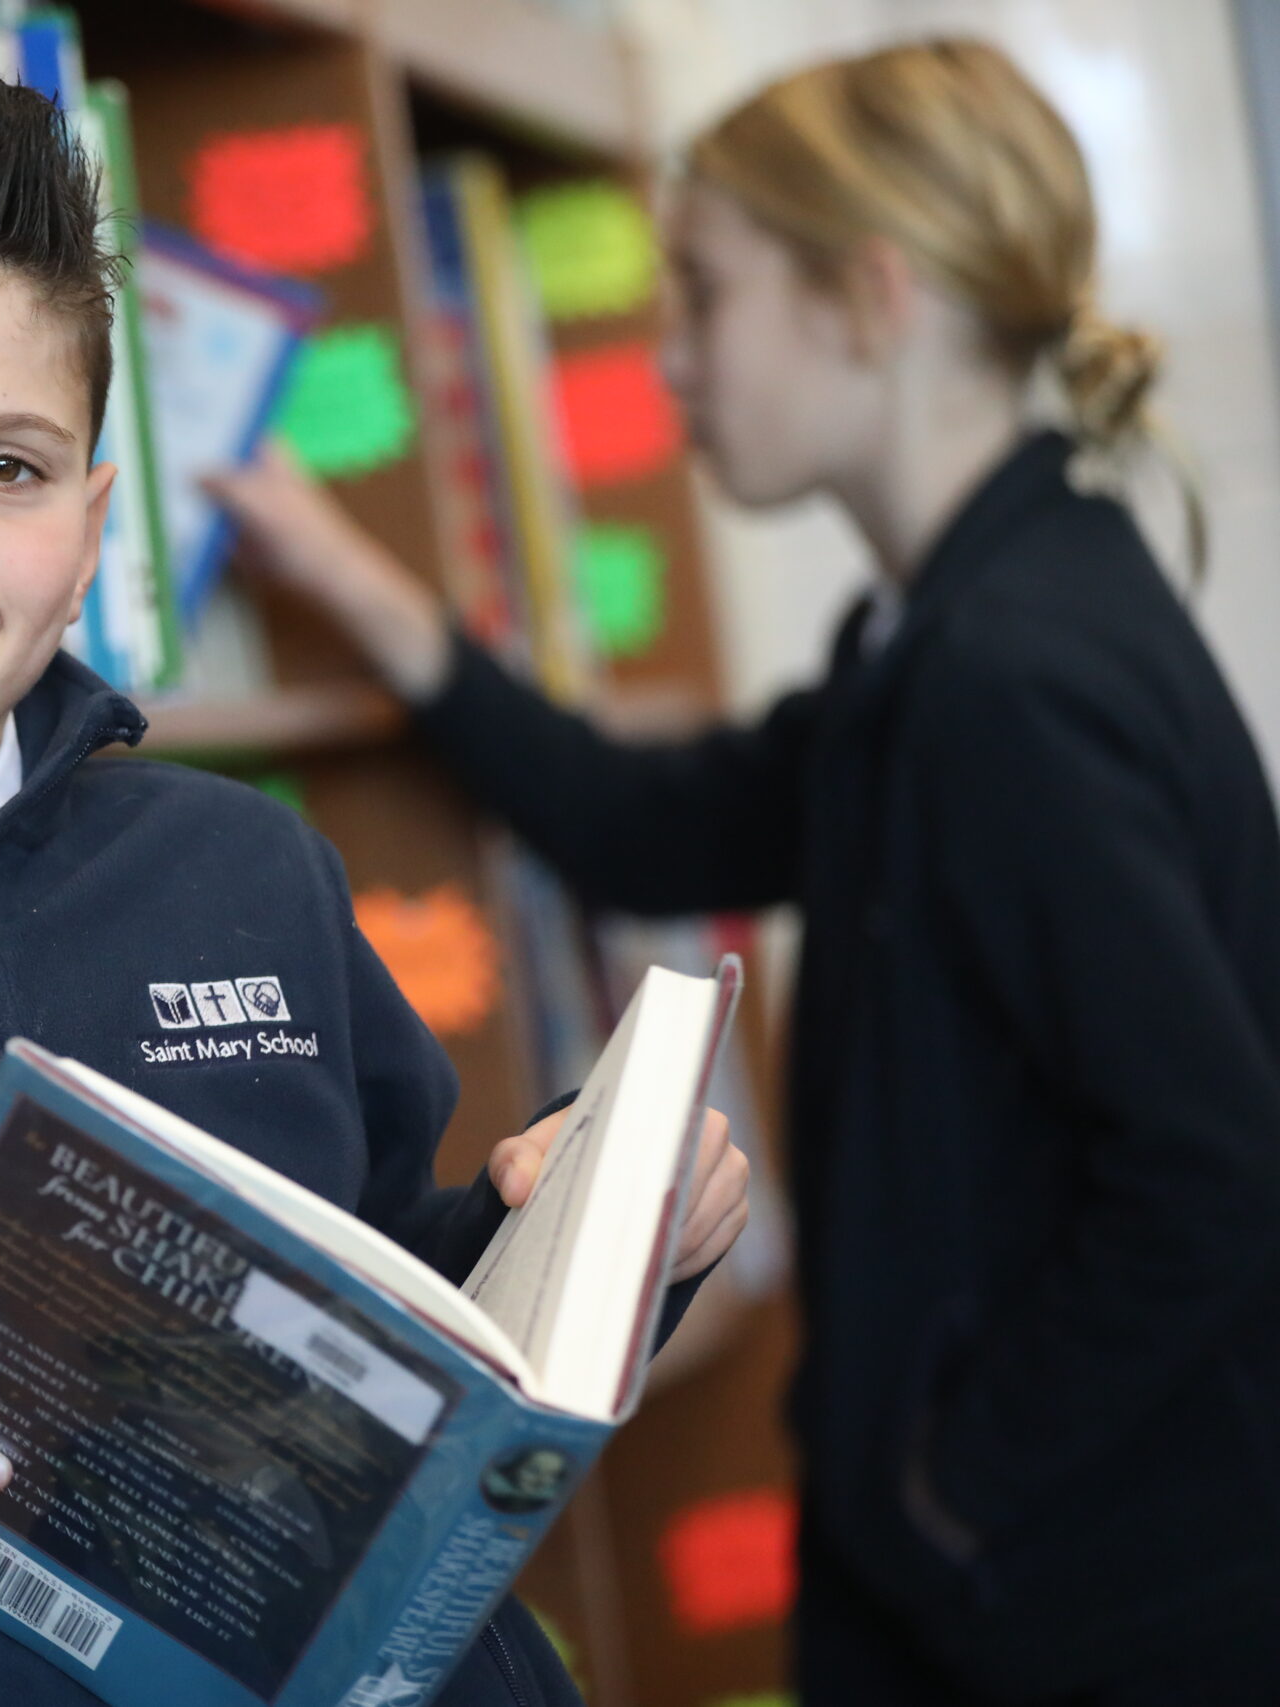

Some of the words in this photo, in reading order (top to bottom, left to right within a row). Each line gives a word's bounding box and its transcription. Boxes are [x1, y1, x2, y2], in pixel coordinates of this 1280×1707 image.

[140, 1038, 194, 1063] Saint
[195, 1037, 252, 1060] Mary
[257, 1029, 320, 1057] School
[36, 1173, 108, 1223] from
[50, 1142, 248, 1278] BEAUTIFU
[60, 1219, 109, 1251] for
[7, 1348, 67, 1391] TEMPEST
[33, 1406, 94, 1448] MEASURE
[127, 1468, 188, 1510] MEASURE
[34, 1446, 65, 1470] TALE
[23, 1499, 45, 1518] OF
[46, 1515, 95, 1551] VENICE
[33, 1487, 97, 1531] NOTHING
[107, 1474, 142, 1500] WELL
[146, 1500, 181, 1525] THAT
[72, 1491, 104, 1516] TWO
[103, 1512, 185, 1569] GENTLEMEN
[185, 1566, 205, 1583] OF
[207, 1582, 262, 1621] VERONA
[107, 1494, 133, 1514] THE
[135, 1512, 191, 1552] COMEDY
[192, 1550, 210, 1566] OF
[214, 1566, 267, 1603] ERRORS
[136, 1574, 154, 1591] AS
[154, 1586, 181, 1608] YOU
[184, 1606, 216, 1631] LIKE
[216, 1628, 232, 1642] IT
[137, 1555, 181, 1587] TIMON
[180, 1583, 199, 1600] OF
[205, 1600, 257, 1638] ATHENS
[376, 1512, 496, 1659] SHAKESPEARE
